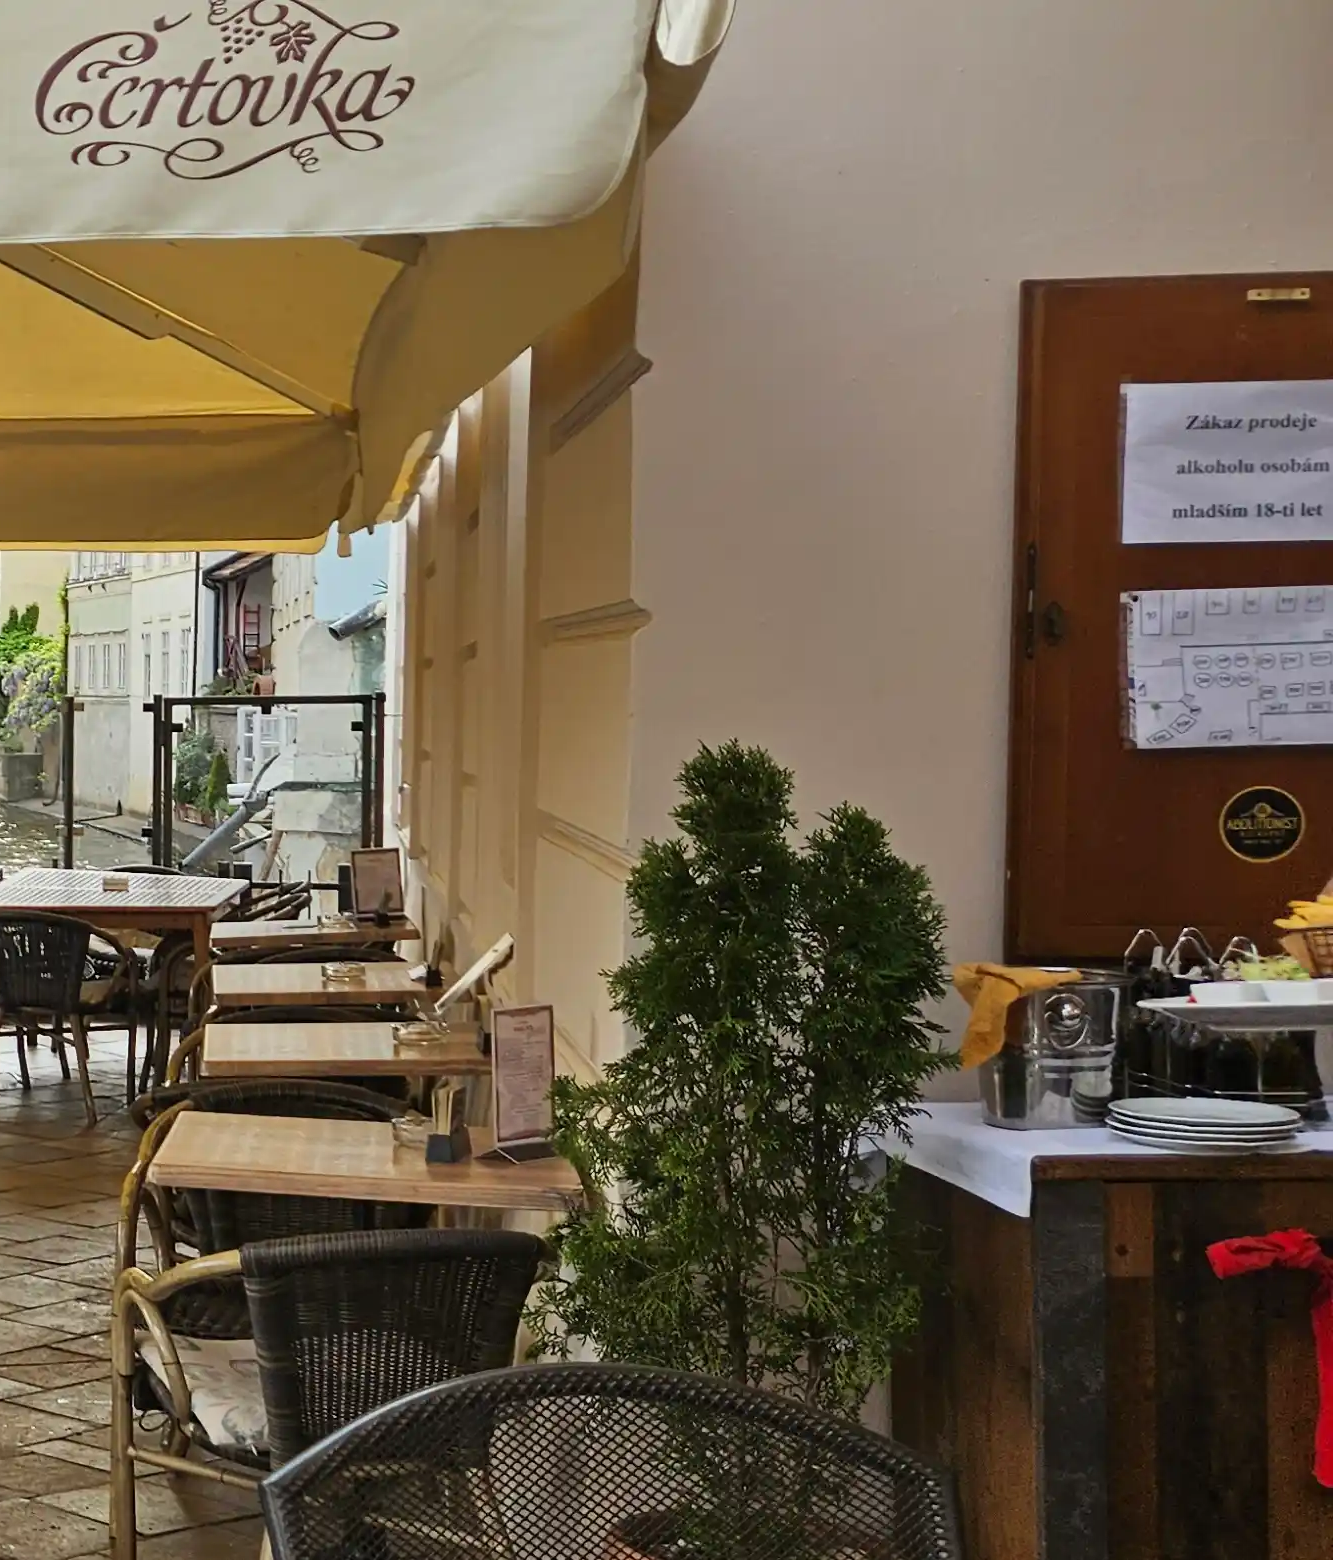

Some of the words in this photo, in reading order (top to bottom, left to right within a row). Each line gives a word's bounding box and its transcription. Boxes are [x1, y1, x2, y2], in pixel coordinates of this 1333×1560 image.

[1186, 414, 1243, 431] Zákaz
[1248, 413, 1318, 433] prodeje
[1176, 459, 1255, 475] alkoholu
[1260, 457, 1331, 474] osobám
[1172, 503, 1249, 519] mladším
[1256, 502, 1295, 518] 18-ti
[1301, 501, 1324, 517] let
